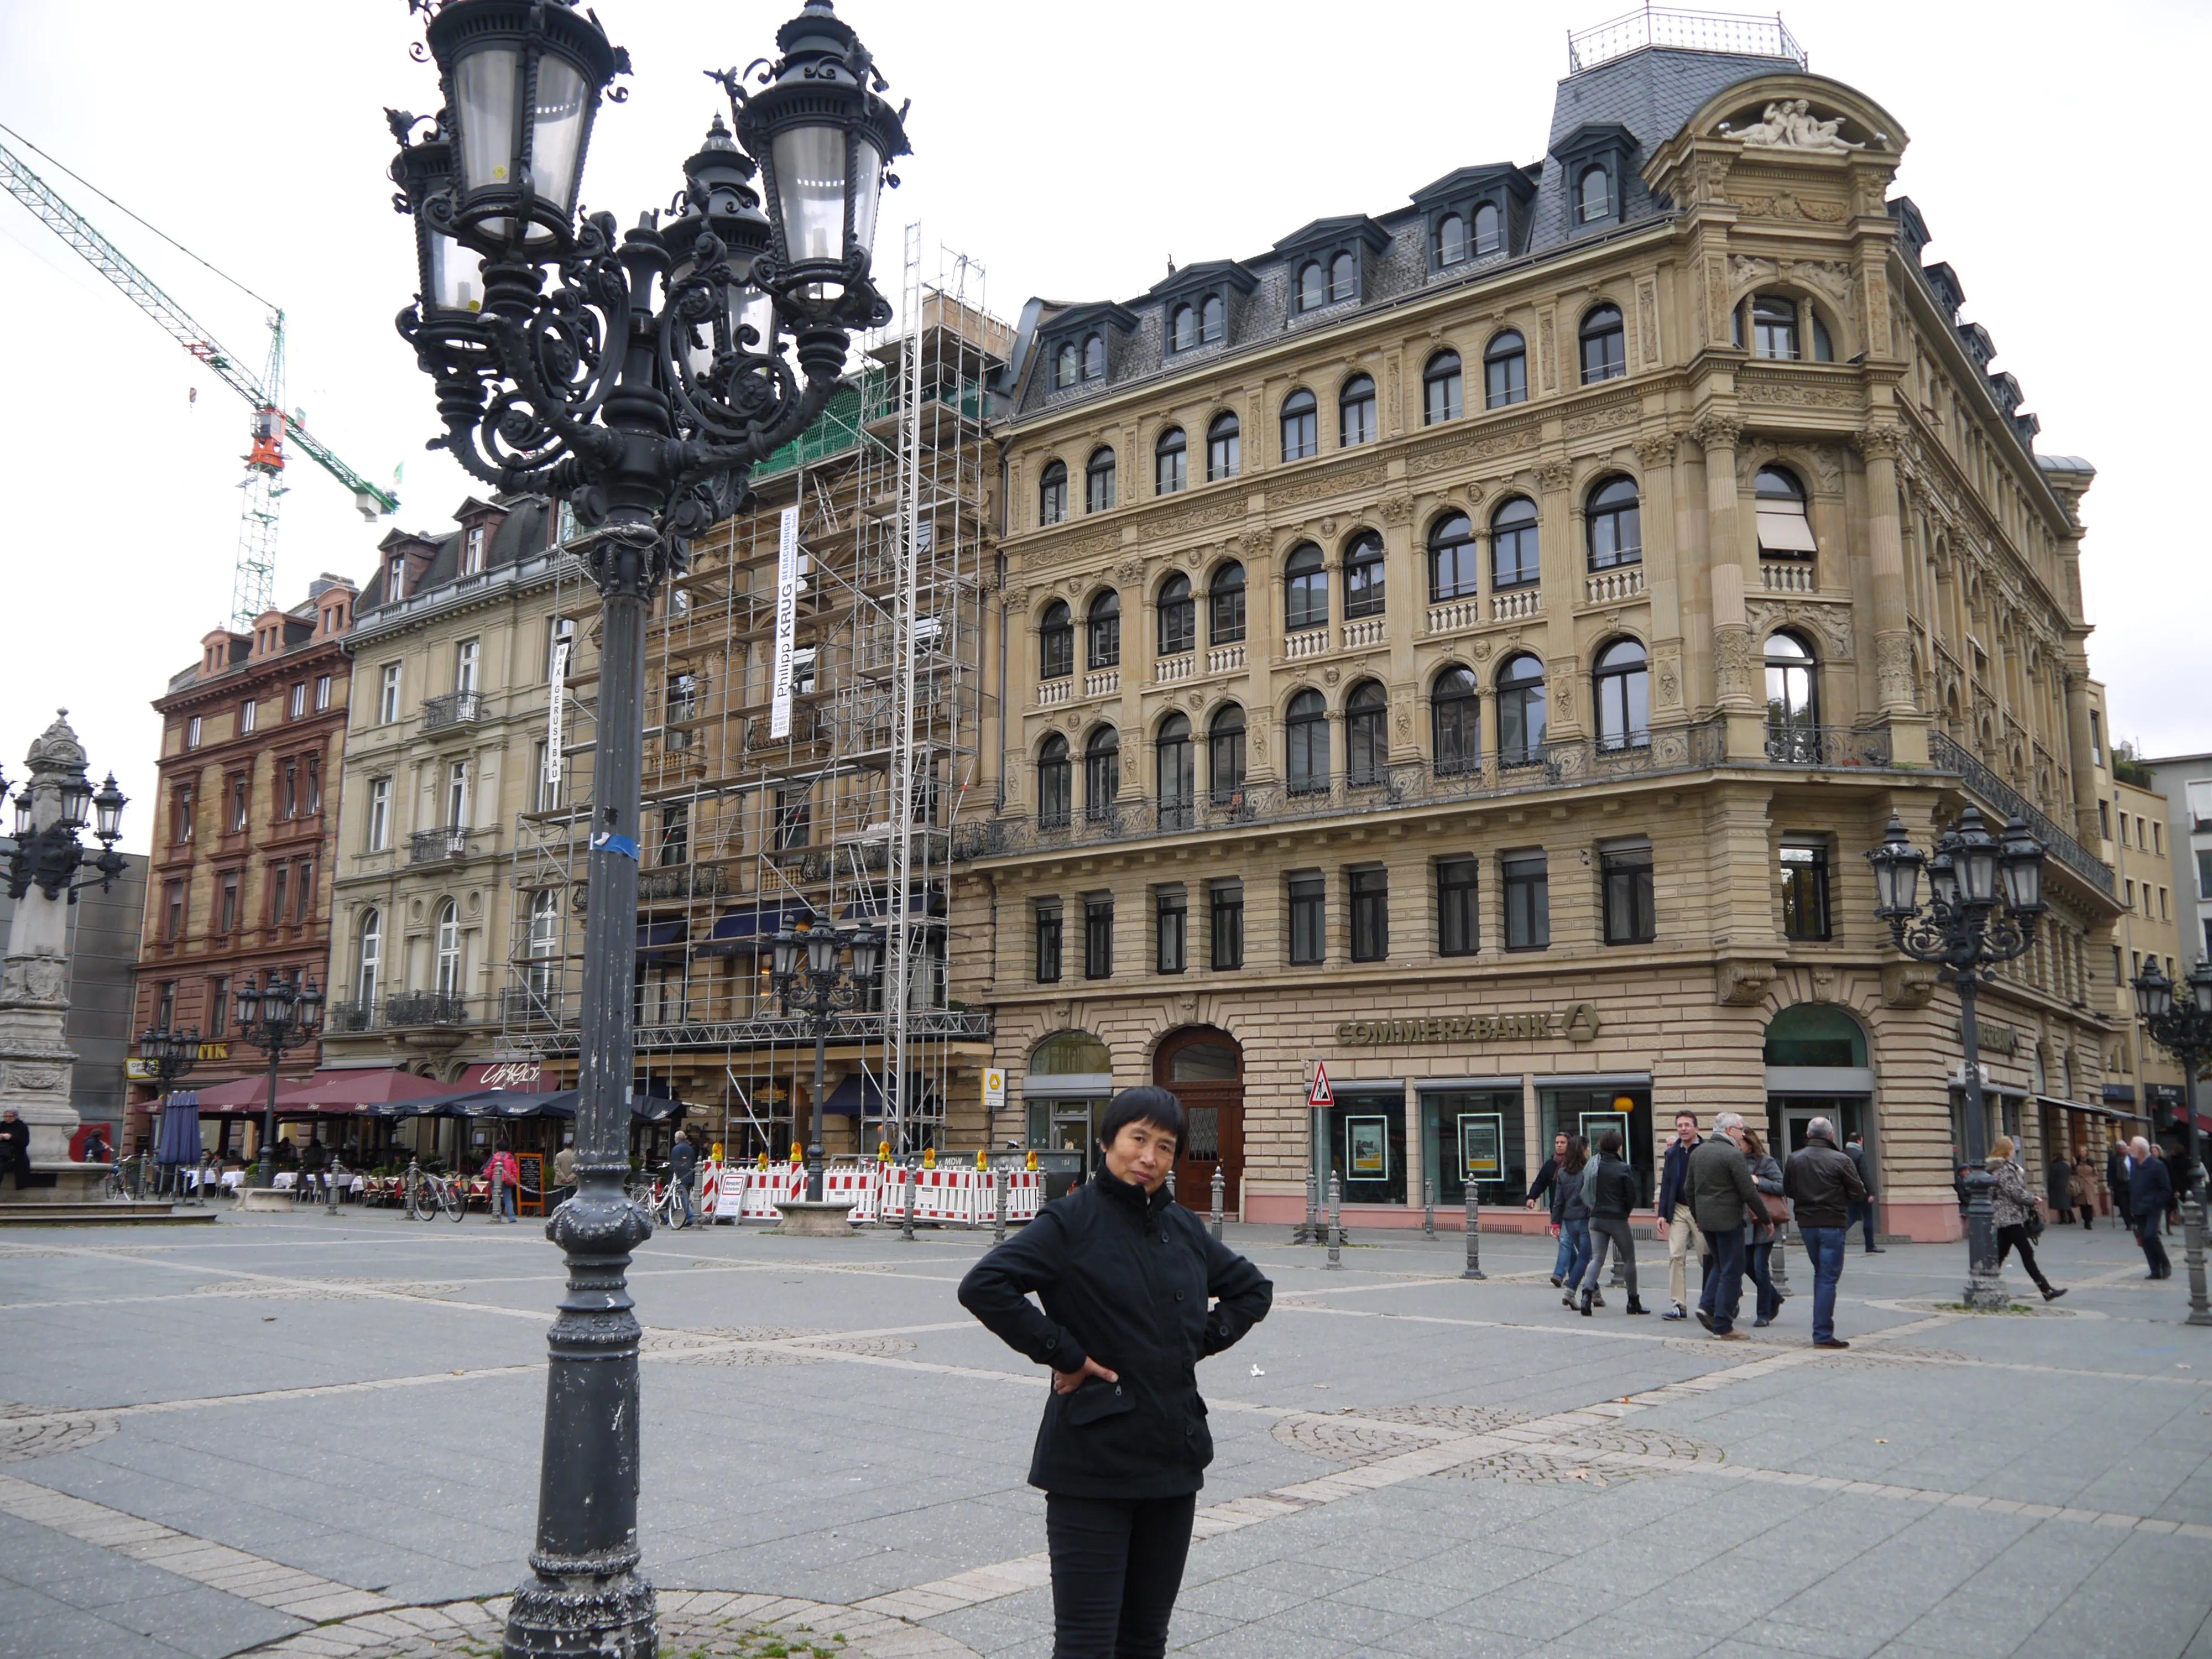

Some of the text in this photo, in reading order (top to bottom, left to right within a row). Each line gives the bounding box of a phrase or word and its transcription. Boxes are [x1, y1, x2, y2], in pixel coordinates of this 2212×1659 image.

[782, 514, 791, 581] BEDACHUNGEN
[780, 583, 792, 639] KRUG
[777, 643, 791, 698] Philipp
[552, 648, 565, 778] MAX GERÜSTBAU
[1335, 1014, 1552, 1045] COMMERZBANK
[945, 1157, 963, 1166] MDW
